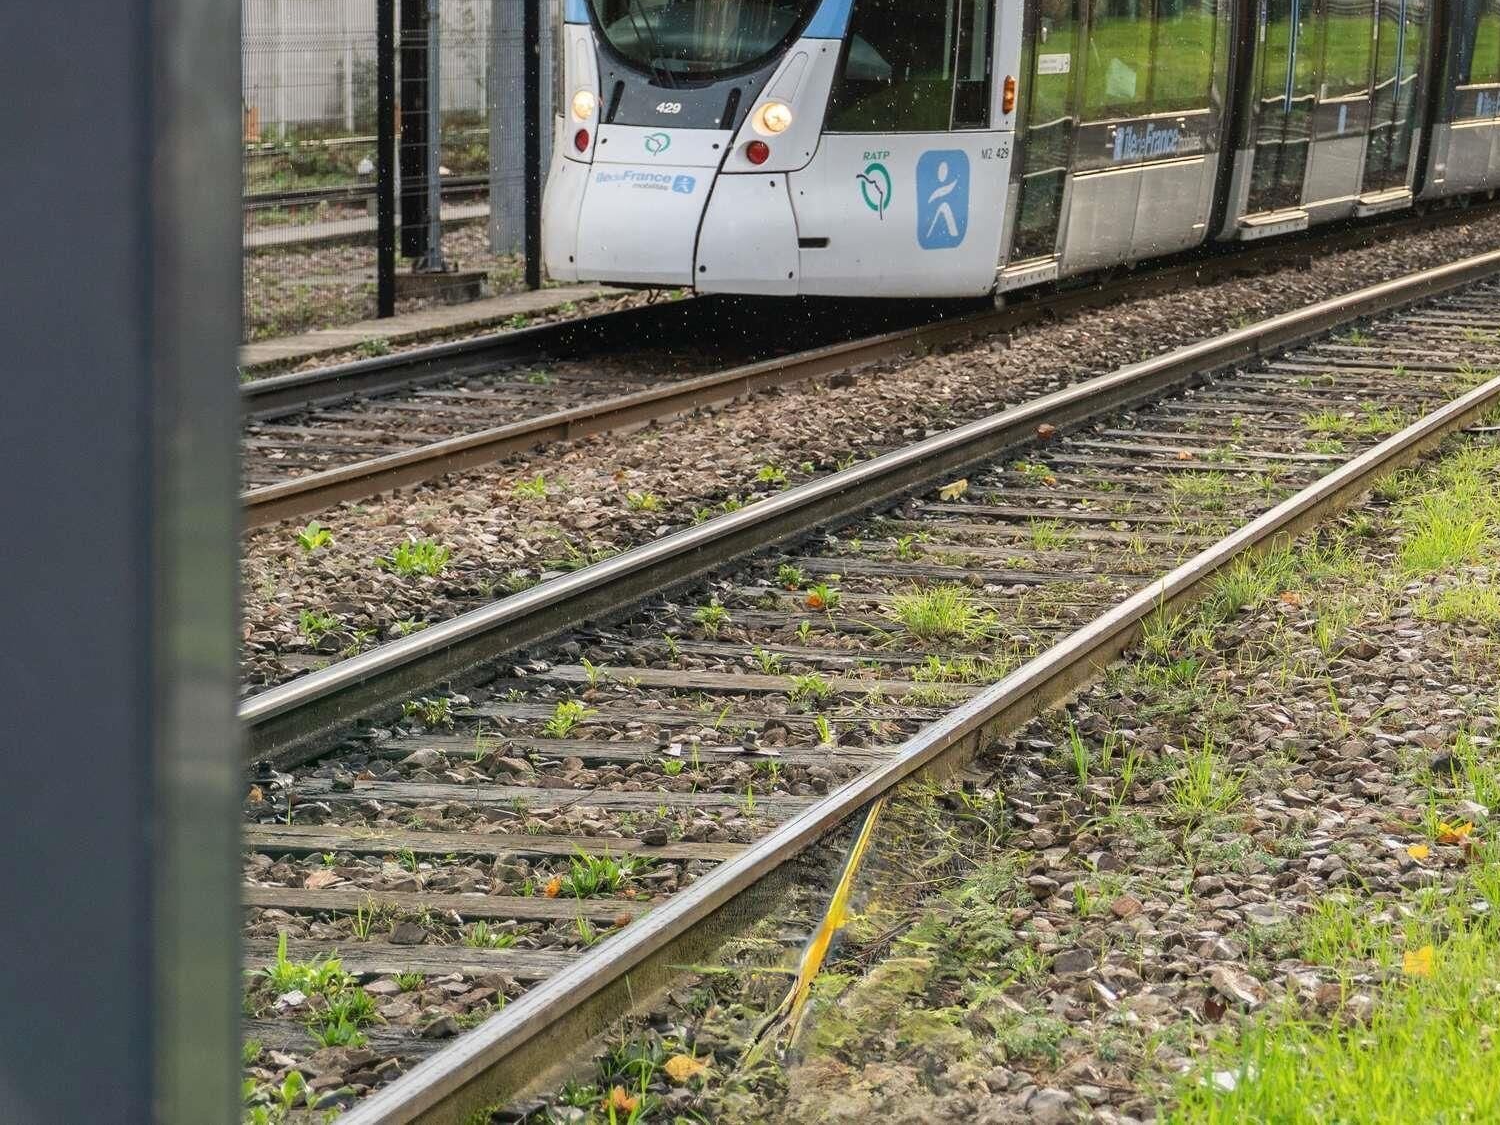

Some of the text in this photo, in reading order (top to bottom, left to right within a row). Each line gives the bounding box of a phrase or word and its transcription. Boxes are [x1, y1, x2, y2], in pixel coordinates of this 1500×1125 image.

[656, 102, 681, 114] 429
[863, 151, 890, 161] RATP
[996, 147, 1009, 159] 429
